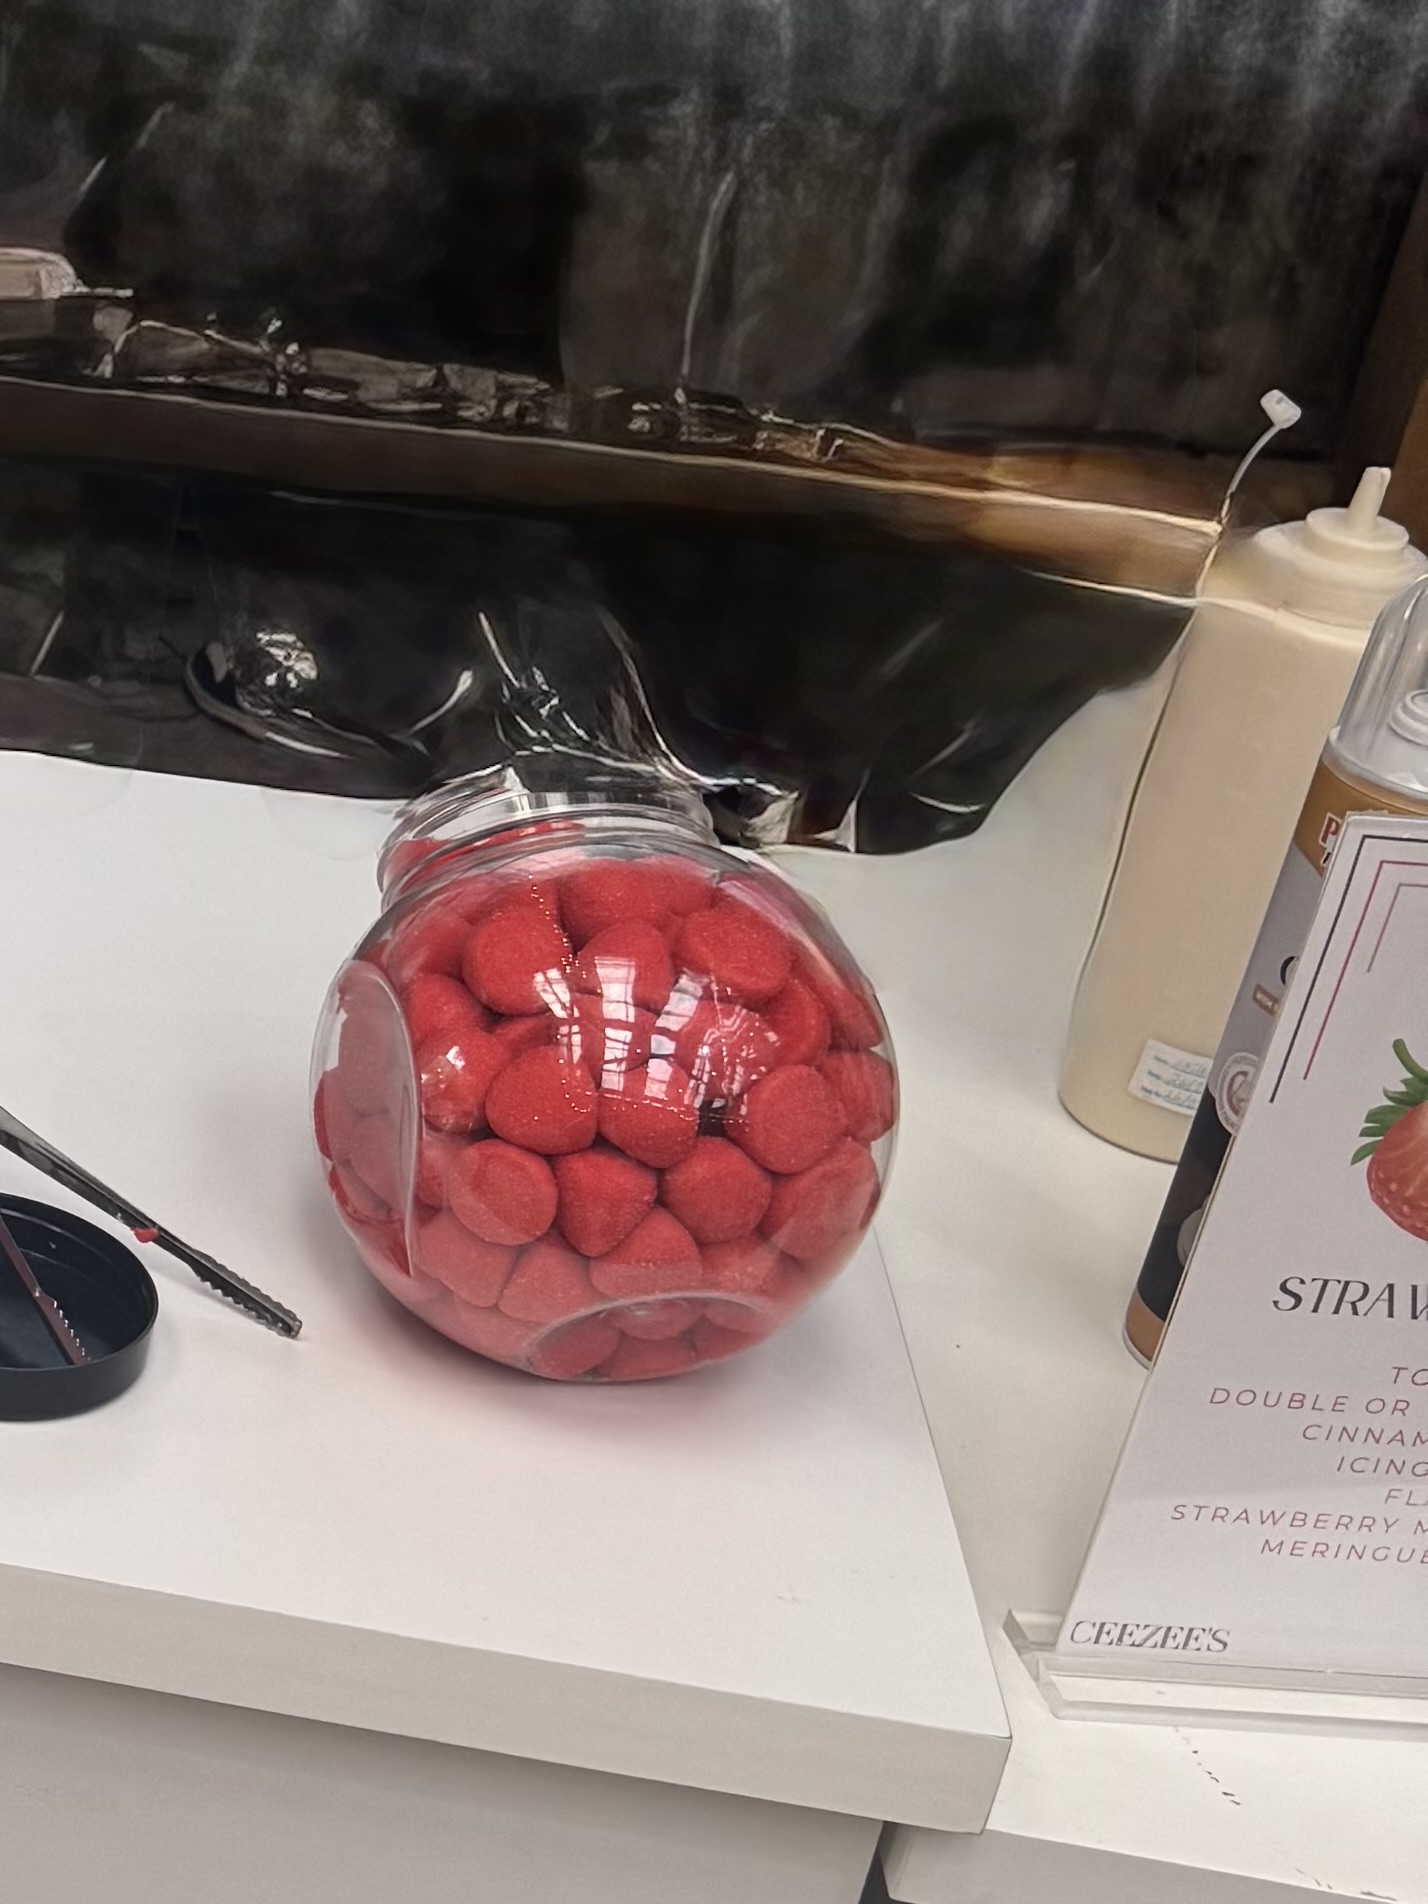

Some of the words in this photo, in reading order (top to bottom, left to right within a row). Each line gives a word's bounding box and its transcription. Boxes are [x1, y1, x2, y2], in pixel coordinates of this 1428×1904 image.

[1209, 1387, 1349, 1413] DOUBLE
[1364, 1397, 1411, 1417] OR
[1171, 1504, 1400, 1534] STRAWBERRY
[1070, 1620, 1231, 1653] CEEZEE'S
